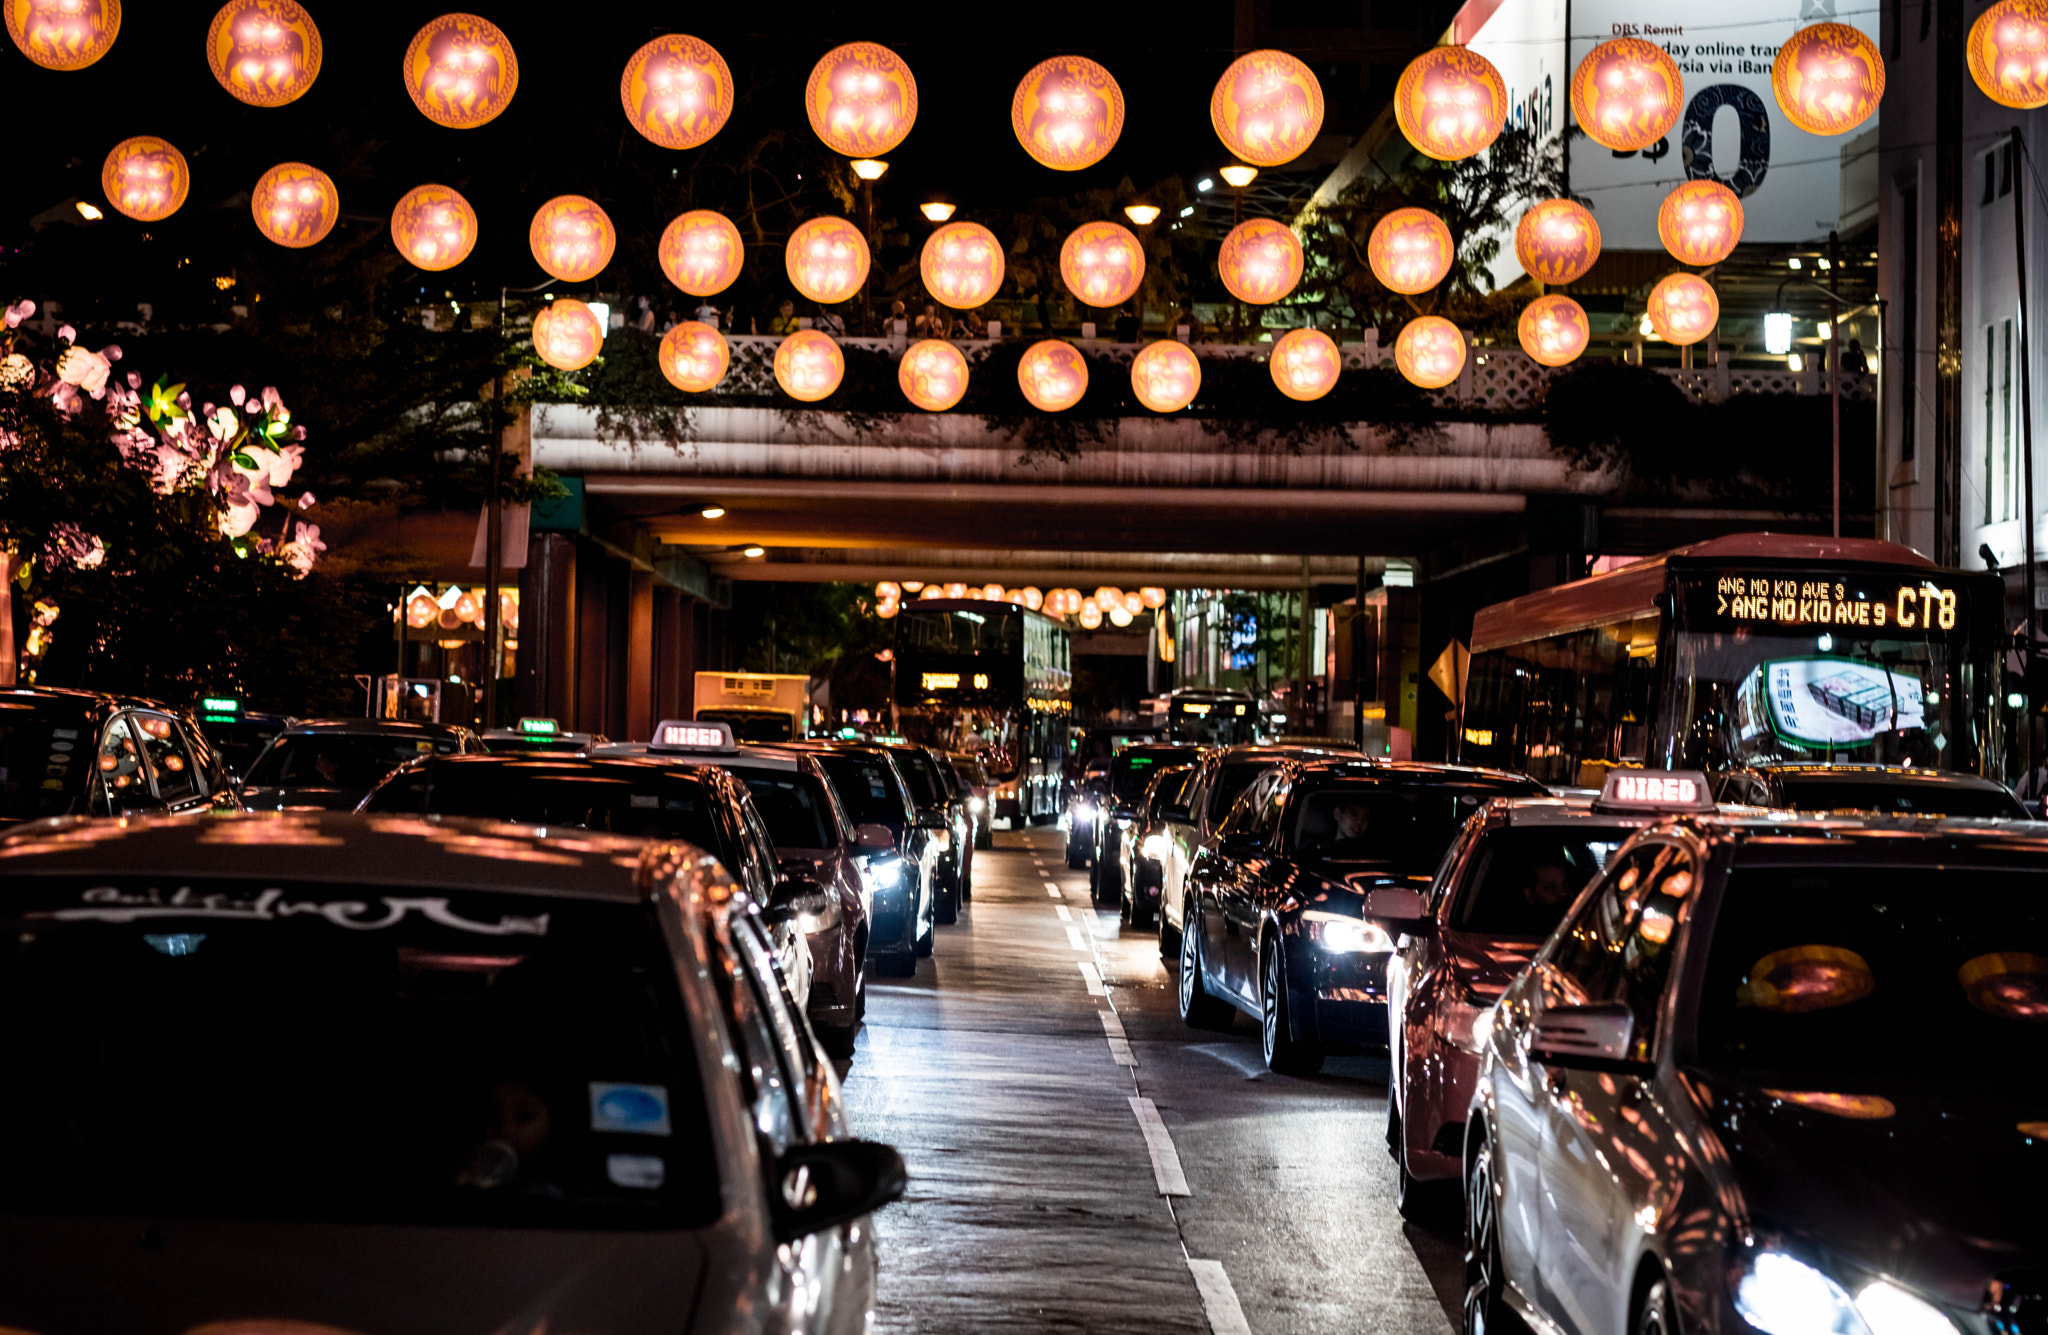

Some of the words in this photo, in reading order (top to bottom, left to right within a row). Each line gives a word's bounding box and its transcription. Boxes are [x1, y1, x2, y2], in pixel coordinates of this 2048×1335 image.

[1612, 23, 1639, 36] DBS
[1644, 24, 1684, 37] Remit
[1695, 42, 1745, 57] online
[1710, 60, 1733, 73] via
[1738, 60, 1773, 74] iBan
[1717, 577, 1746, 595] ANG
[1751, 578, 1769, 596] MO
[1774, 580, 1797, 598] KIO
[1802, 582, 1830, 600] AVE
[1731, 595, 1769, 620] ANG
[1771, 597, 1796, 621] MO
[1800, 598, 1832, 624] KIO
[1835, 600, 1870, 626] AVE
[1873, 602, 1886, 627] 9
[1897, 586, 1956, 630] CT8
[665, 726, 723, 746] HIRED
[1617, 776, 1697, 802] HIRED
